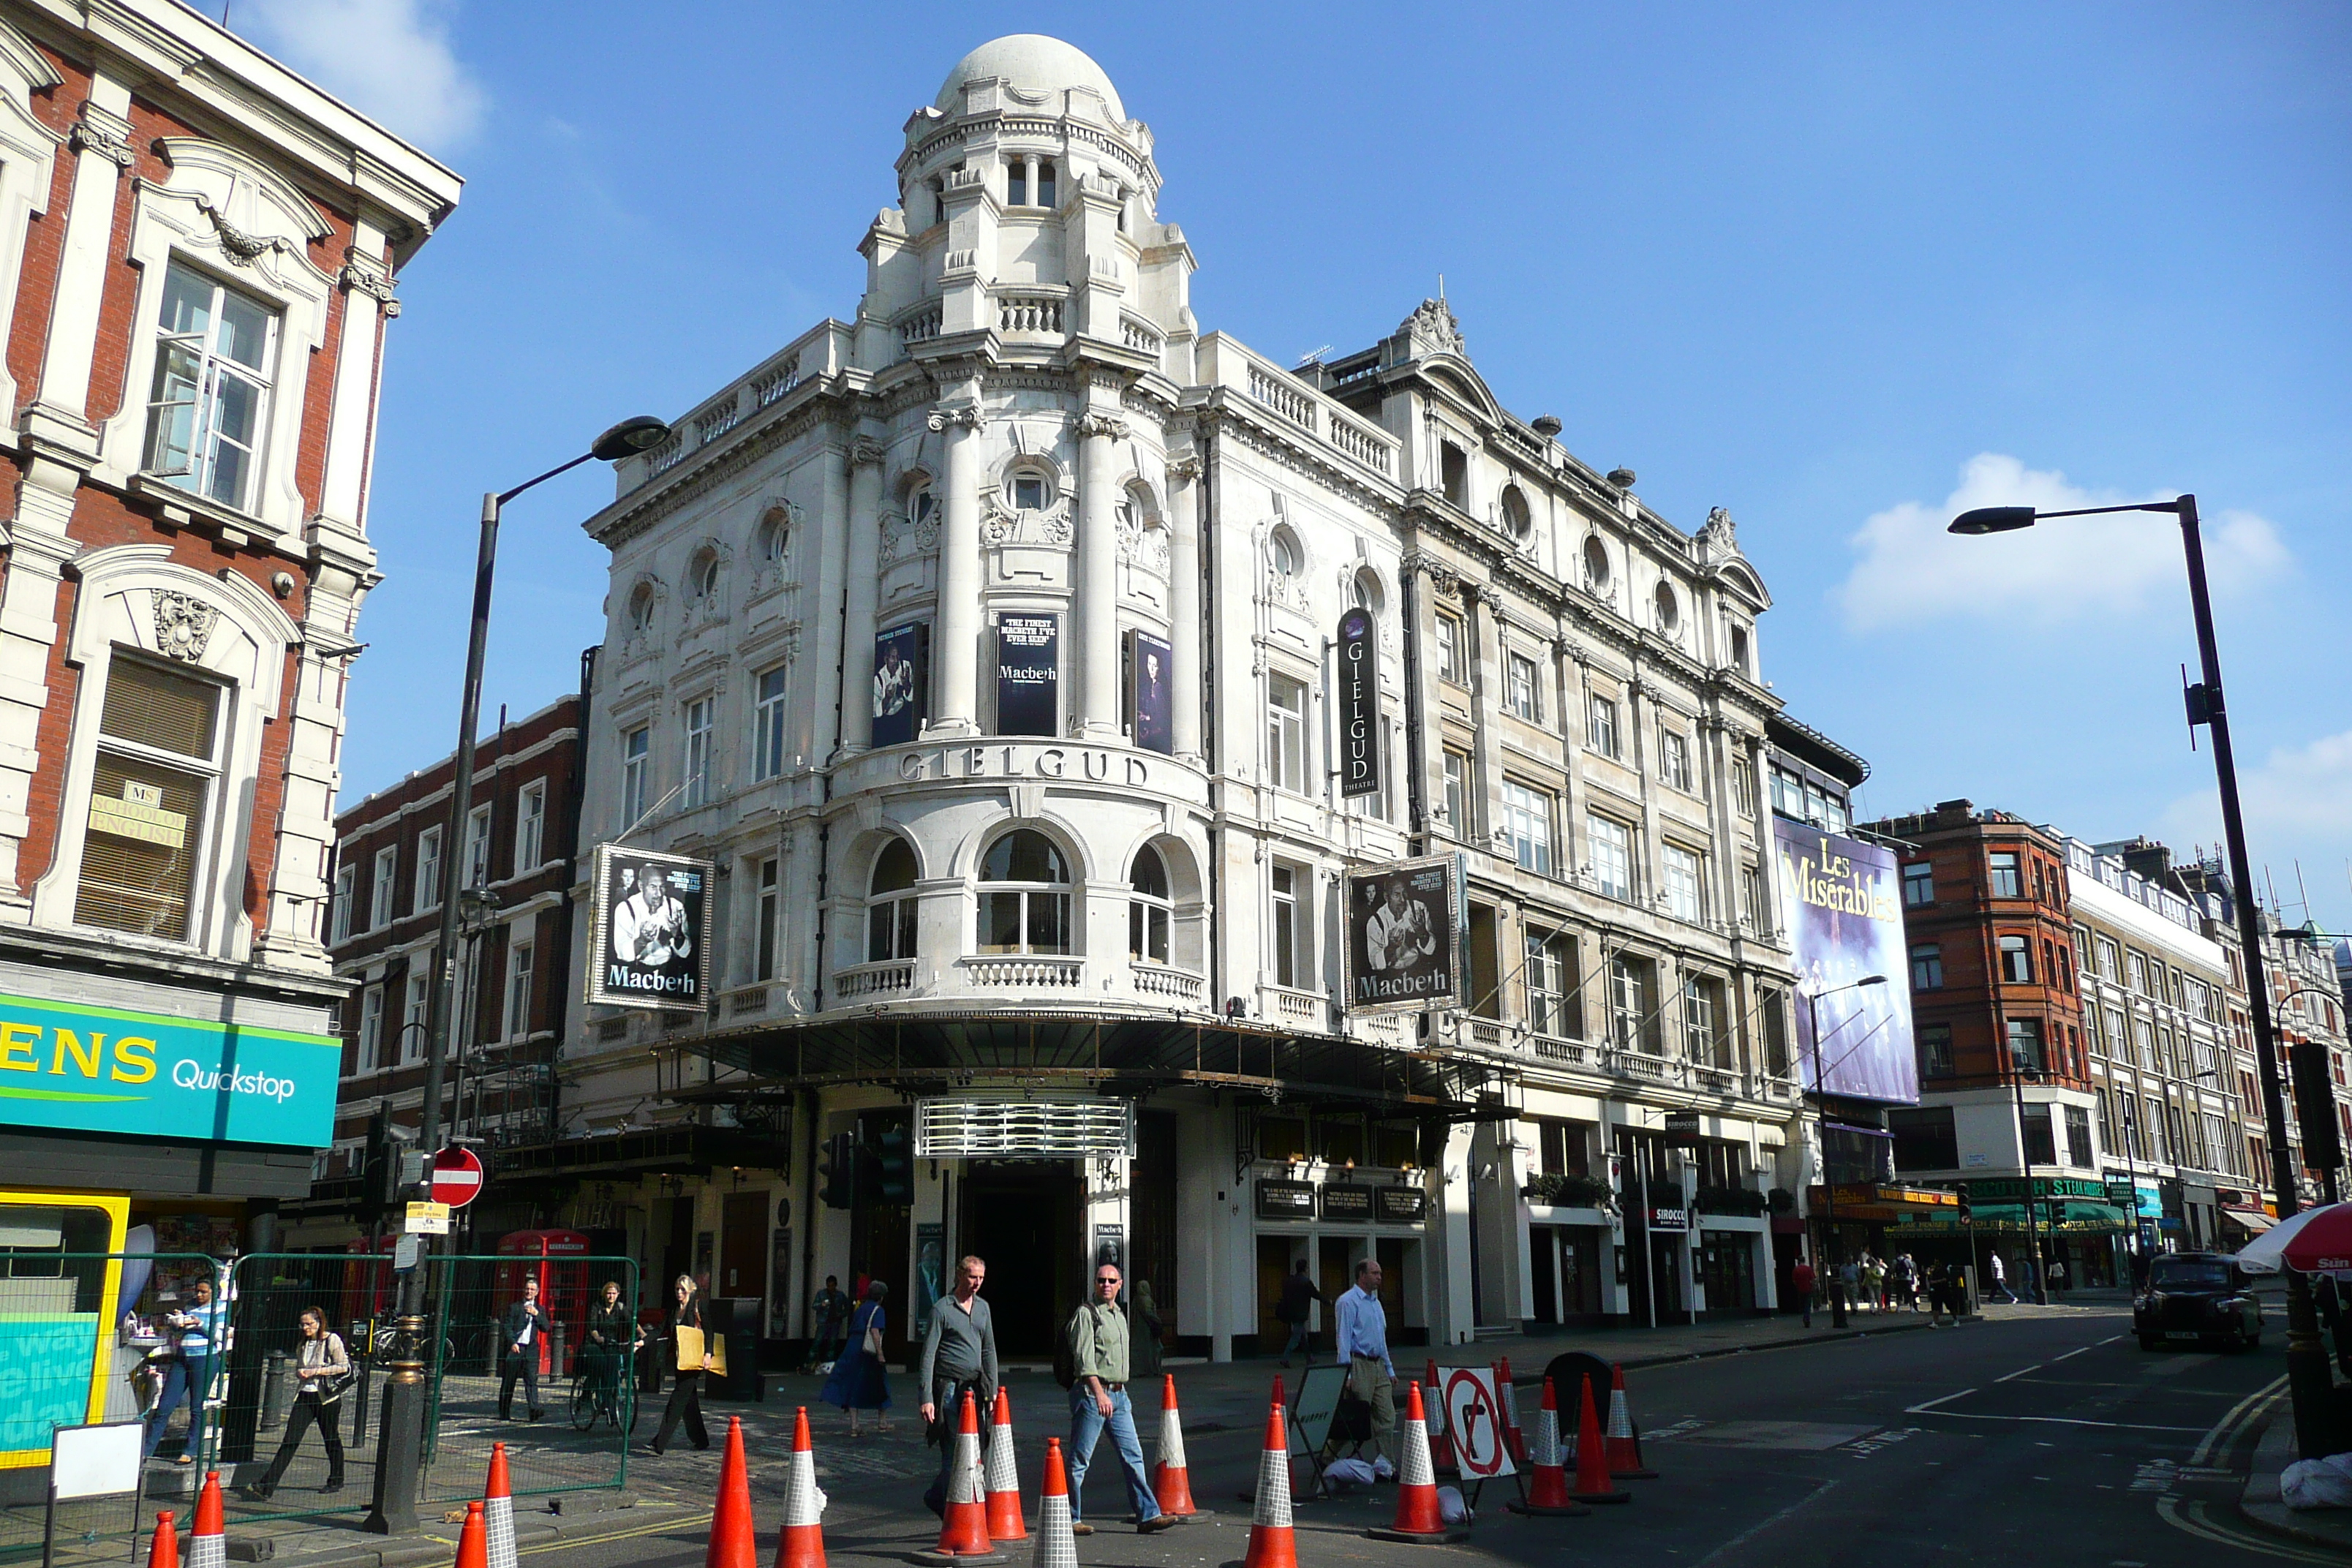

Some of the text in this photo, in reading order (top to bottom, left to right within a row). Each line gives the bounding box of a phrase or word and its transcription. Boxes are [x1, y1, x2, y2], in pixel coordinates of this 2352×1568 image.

[1348, 641, 1368, 780] GIELGUD
[900, 746, 1148, 787] GIELGUD
[1344, 780, 1375, 792] THEATRE
[93, 813, 182, 847] ENGLISH
[94, 796, 161, 823] SCHOOL
[1819, 837, 1850, 879] Les
[1782, 851, 1896, 922] Misérables
[173, 1058, 295, 1103] Quickstop
